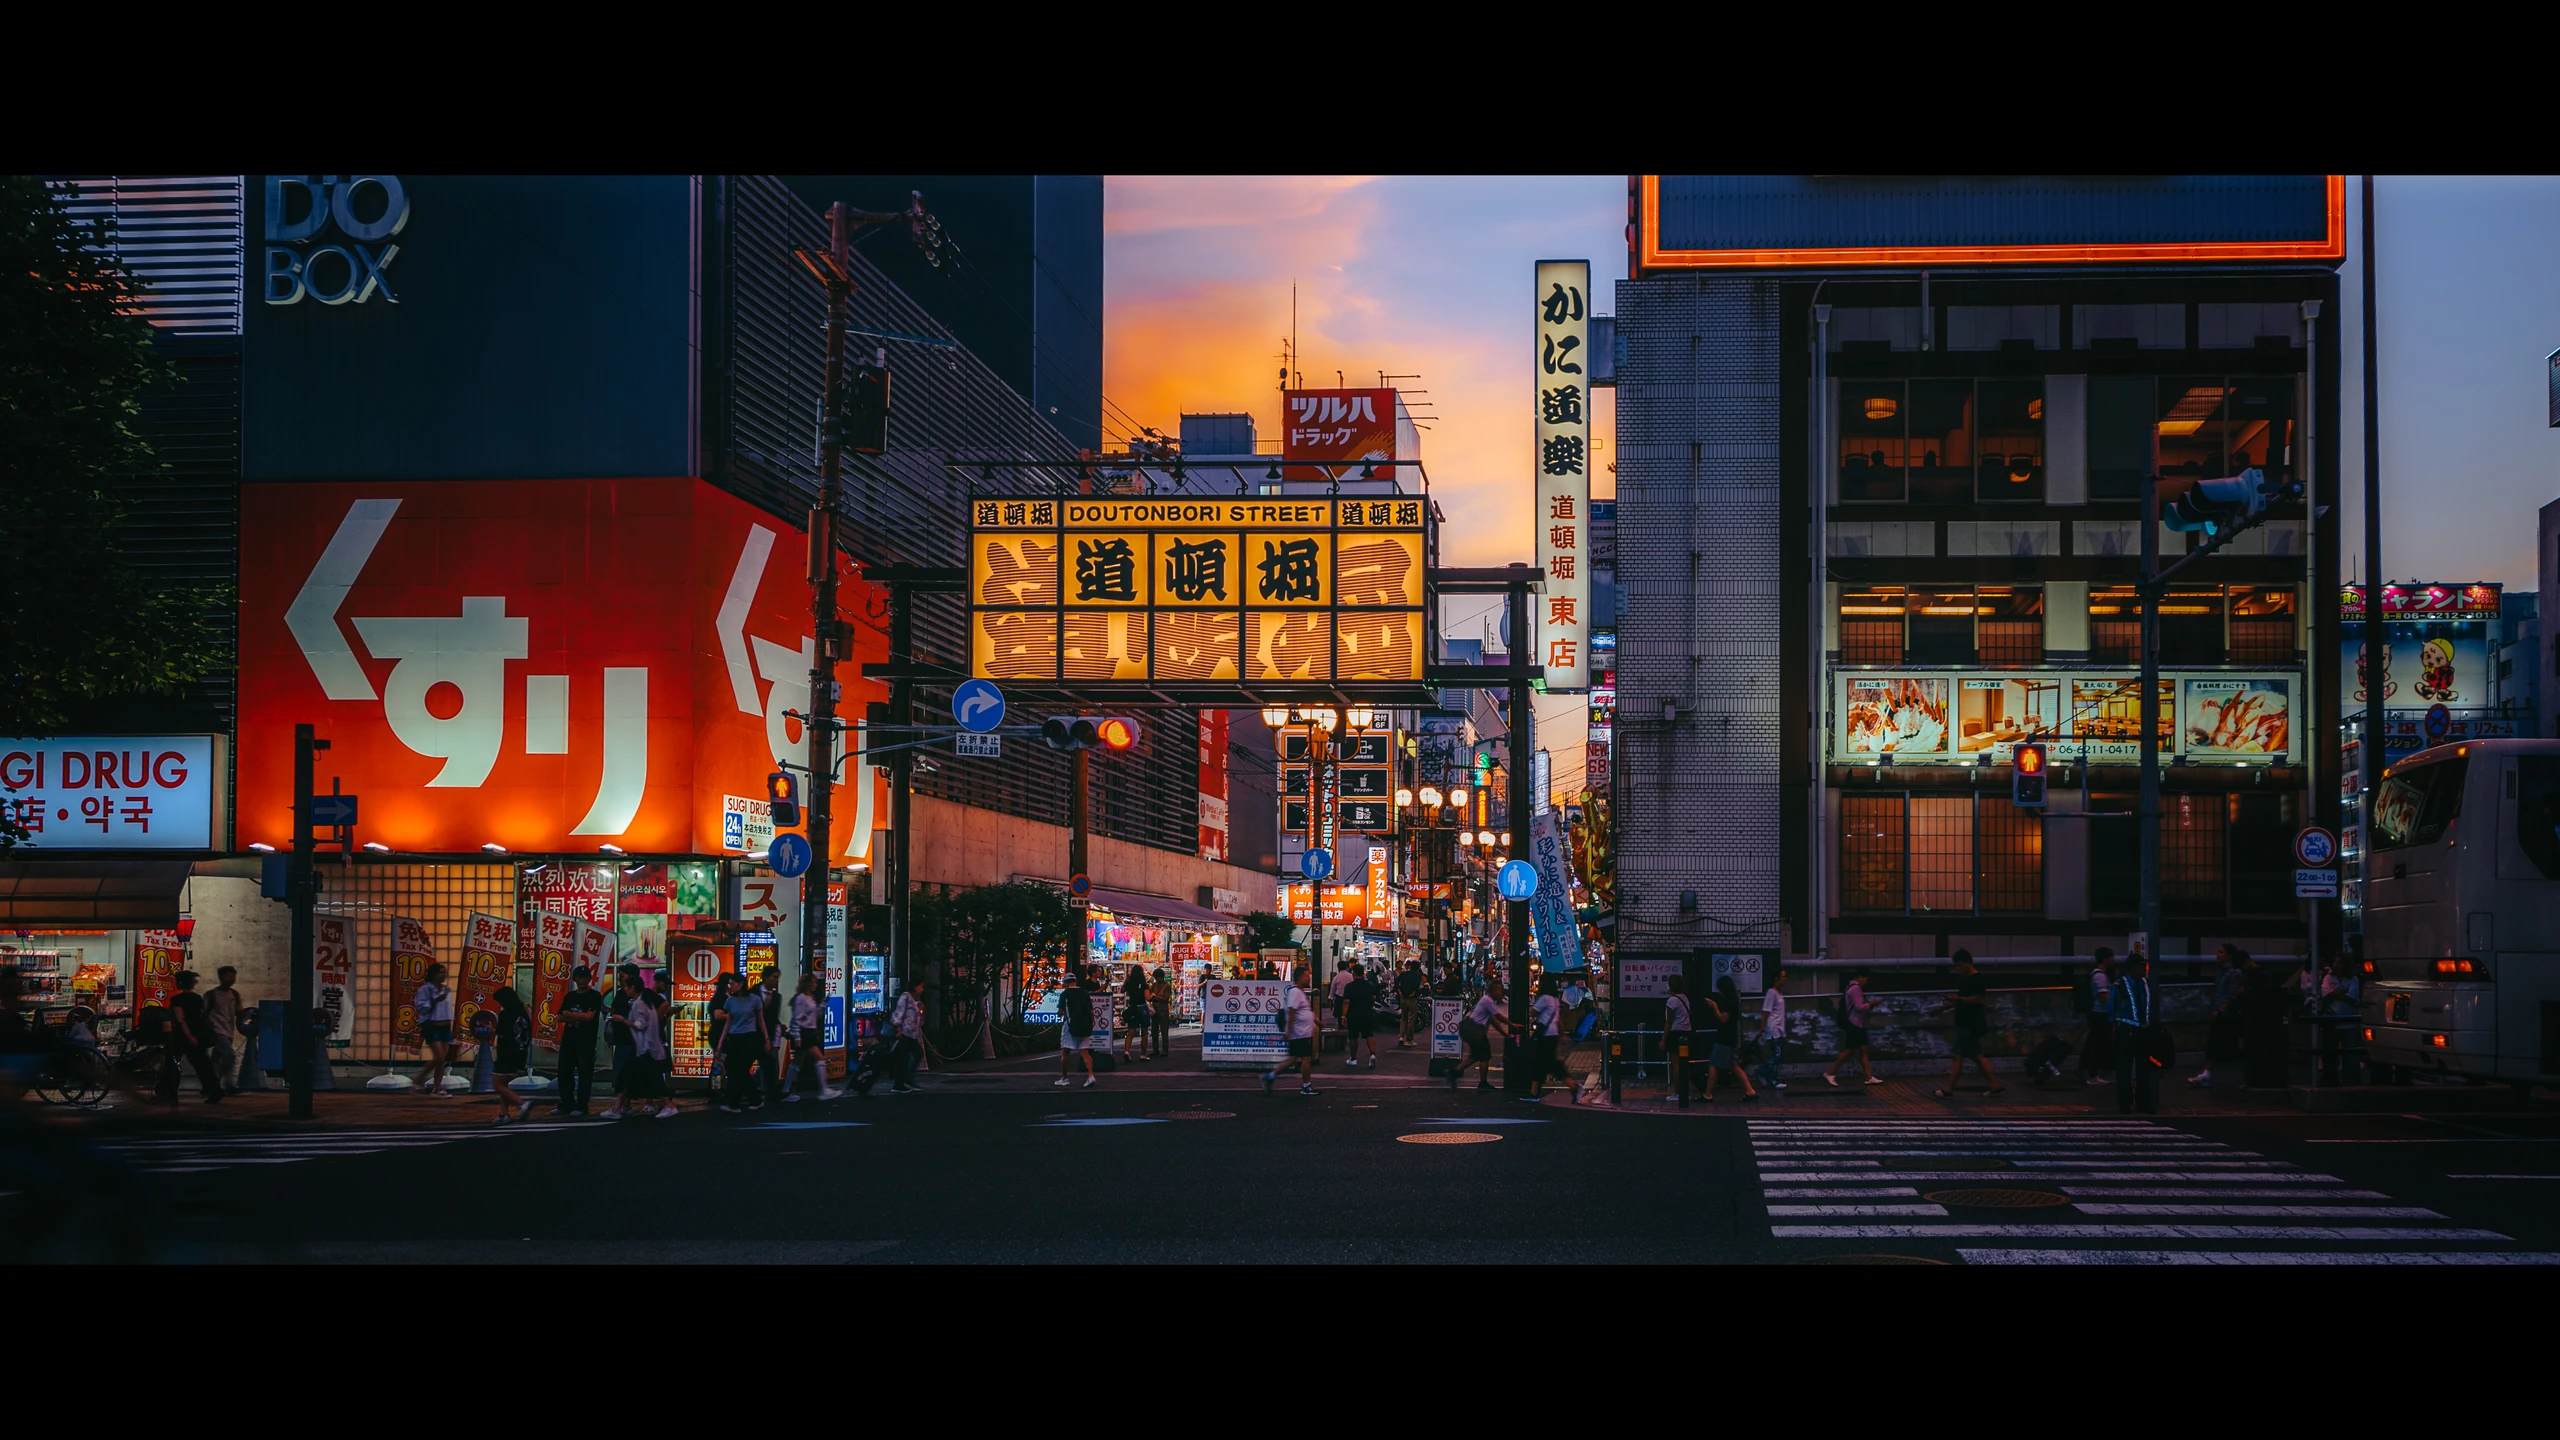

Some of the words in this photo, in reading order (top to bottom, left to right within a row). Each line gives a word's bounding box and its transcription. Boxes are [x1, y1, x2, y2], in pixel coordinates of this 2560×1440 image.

[265, 244, 399, 305] BOX
[1291, 396, 1376, 424] ツルハ
[1291, 427, 1357, 446] ドラッグ
[977, 502, 1053, 526] 道頓堀
[1070, 505, 1221, 522] DOUTONBORI
[1230, 505, 1326, 522] STREET
[1342, 502, 1419, 526] 道頓堀
[1075, 537, 1321, 602] 道頓堀
[1548, 494, 1577, 669] 道頓堀東店
[2362, 589, 2474, 610] ャラント
[284, 498, 648, 836] くすり
[958, 735, 998, 745] 左折禁止
[2384, 739, 2421, 749] ンション
[1588, 743, 1607, 757] NEW
[2058, 744, 2138, 755] 06-6211-0417
[0, 752, 44, 788] GI
[62, 752, 188, 788] DRUG
[1588, 760, 1607, 774] 68
[728, 797, 747, 813] SUGI
[750, 801, 771, 817] DRUG
[726, 815, 742, 835] 24h
[725, 836, 742, 846] OPEN
[1371, 848, 1384, 862] 薬
[522, 867, 613, 893] 热烈欢迎
[1374, 868, 1385, 908] アカカベ
[620, 885, 667, 894] 어서오십시오
[522, 896, 611, 922] 中国旅客
[473, 917, 512, 943] 免税
[145, 936, 160, 945] Tax
[162, 937, 182, 948] Free
[401, 942, 416, 951] Tax
[473, 937, 488, 948] Tax
[489, 942, 508, 953] Free
[557, 938, 574, 950] Free
[315, 946, 352, 972] 24
[467, 950, 505, 982] 10%
[826, 967, 842, 980] RUG
[1624, 964, 1679, 972] 自転車・バイクの
[322, 973, 346, 985] 時間
[1228, 986, 1279, 996] 進入禁止
[1024, 1013, 1041, 1023] 24h
[1219, 1015, 1276, 1024] 歩行者専用道
[675, 1067, 688, 1075] TEL
